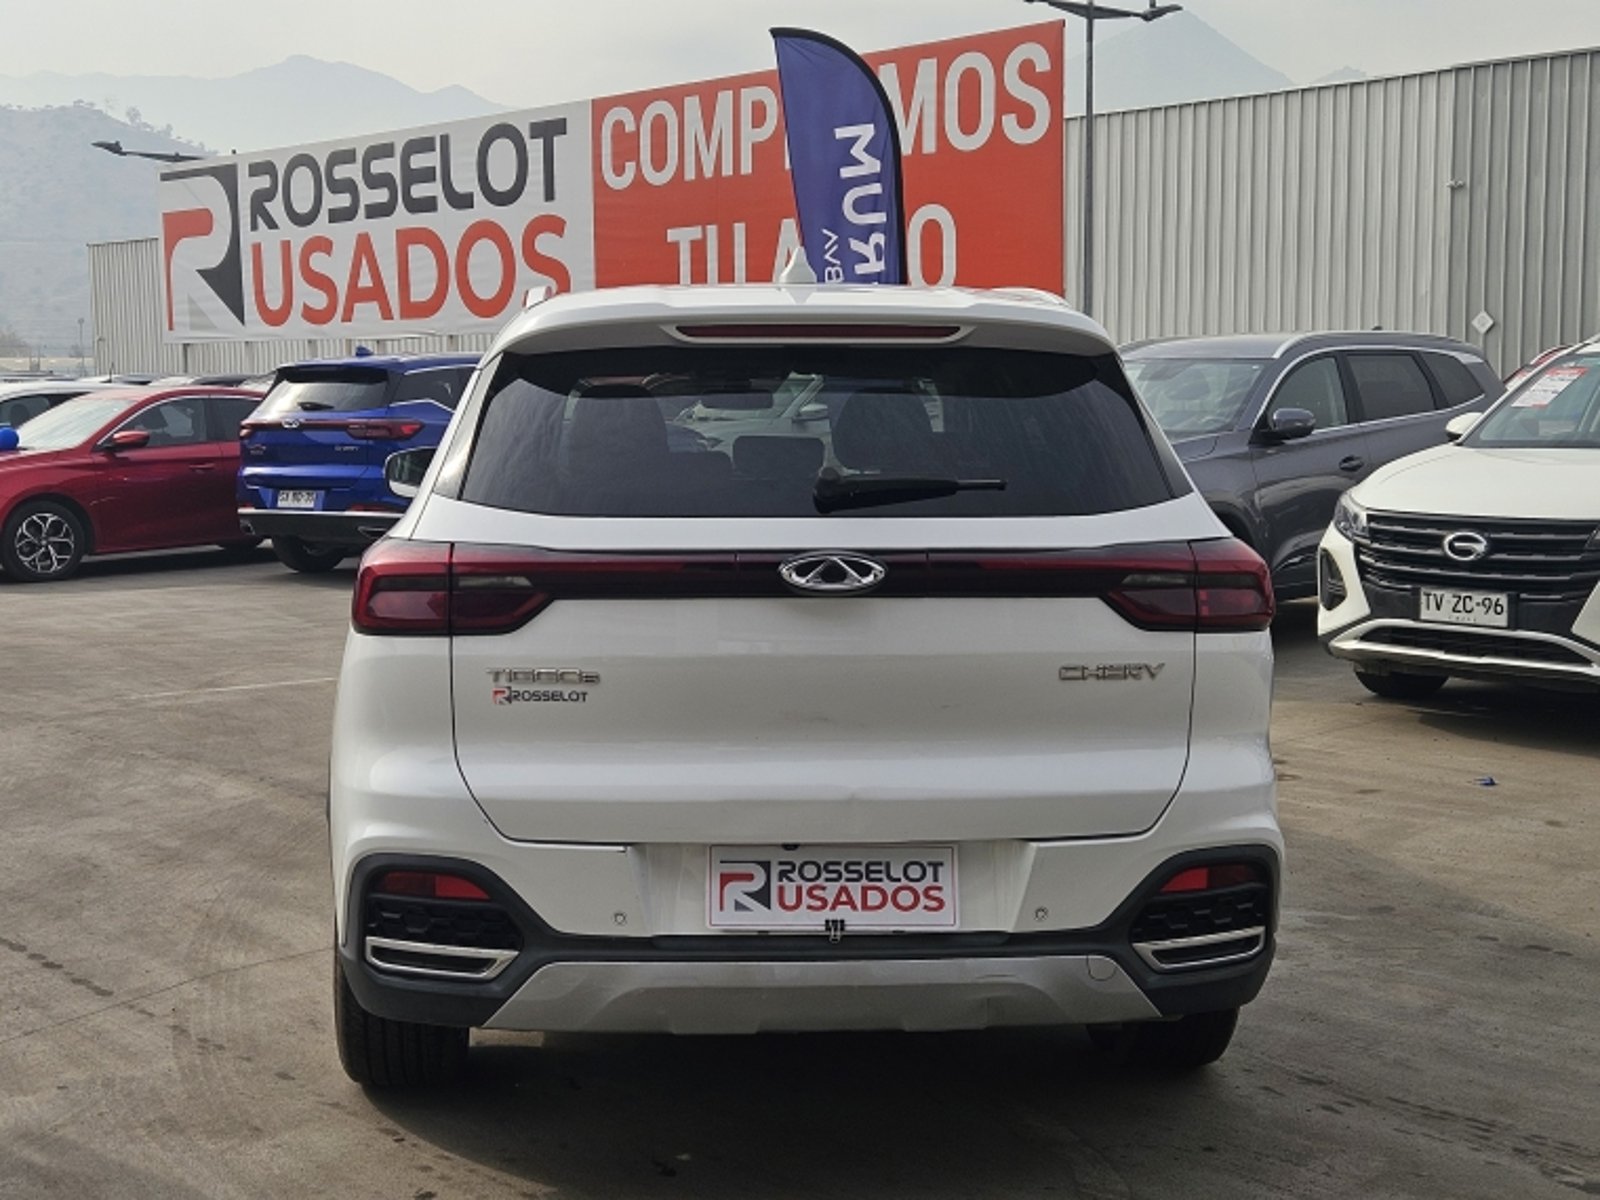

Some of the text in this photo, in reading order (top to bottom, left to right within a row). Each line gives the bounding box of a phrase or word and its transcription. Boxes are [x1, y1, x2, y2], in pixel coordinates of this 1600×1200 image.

[601, 42, 1051, 190] COMPMOS
[249, 117, 567, 232] ROSSELOT
[772, 204, 956, 287] AO
[251, 214, 571, 326] USADOS
[1423, 592, 1444, 611] TV
[1058, 663, 1165, 680] CHERY
[511, 690, 588, 702] ROSSELOT
[777, 861, 944, 883] ROSSELOT
[777, 884, 945, 912] USADOS
